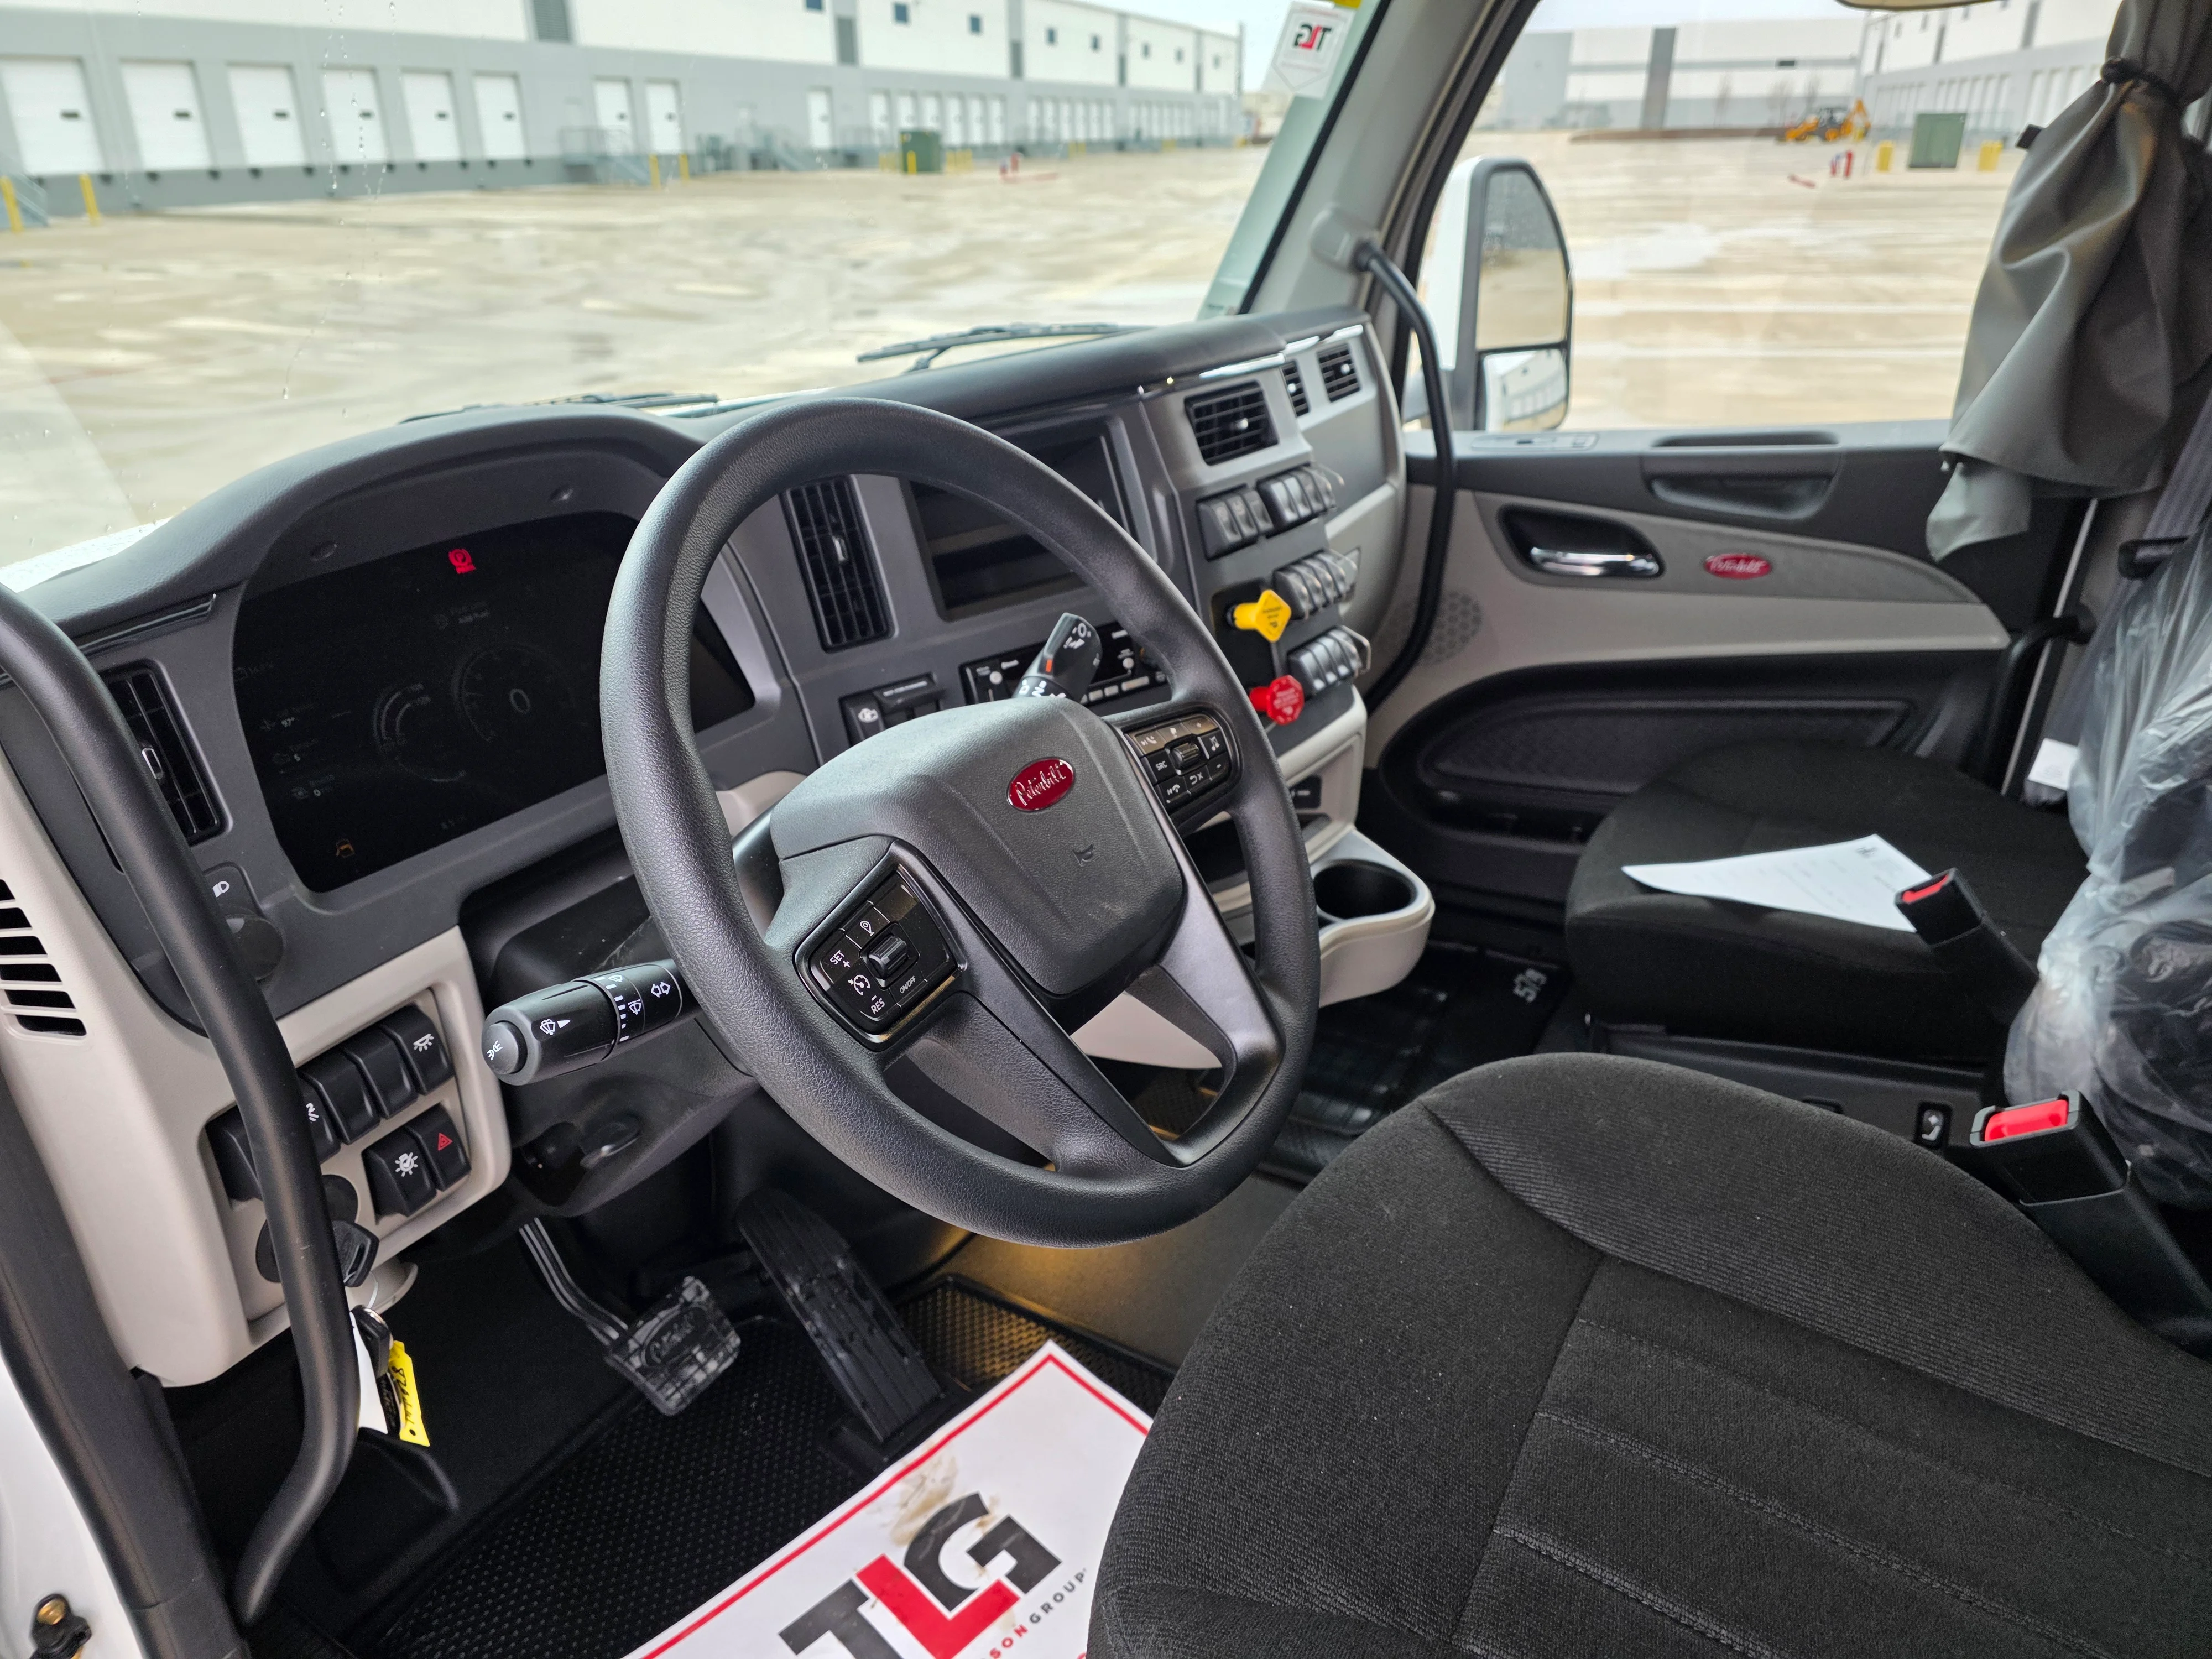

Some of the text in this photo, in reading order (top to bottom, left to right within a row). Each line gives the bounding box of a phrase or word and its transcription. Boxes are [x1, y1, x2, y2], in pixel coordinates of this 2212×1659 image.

[1155, 760, 1168, 771] SRC
[1015, 763, 1066, 806] Peterbilt
[830, 950, 846, 965] SET
[899, 975, 916, 994] ON/OFF
[870, 998, 886, 1015] RES
[778, 1491, 1063, 1659] TLG
[981, 1571, 1087, 1659] SON GROUP
